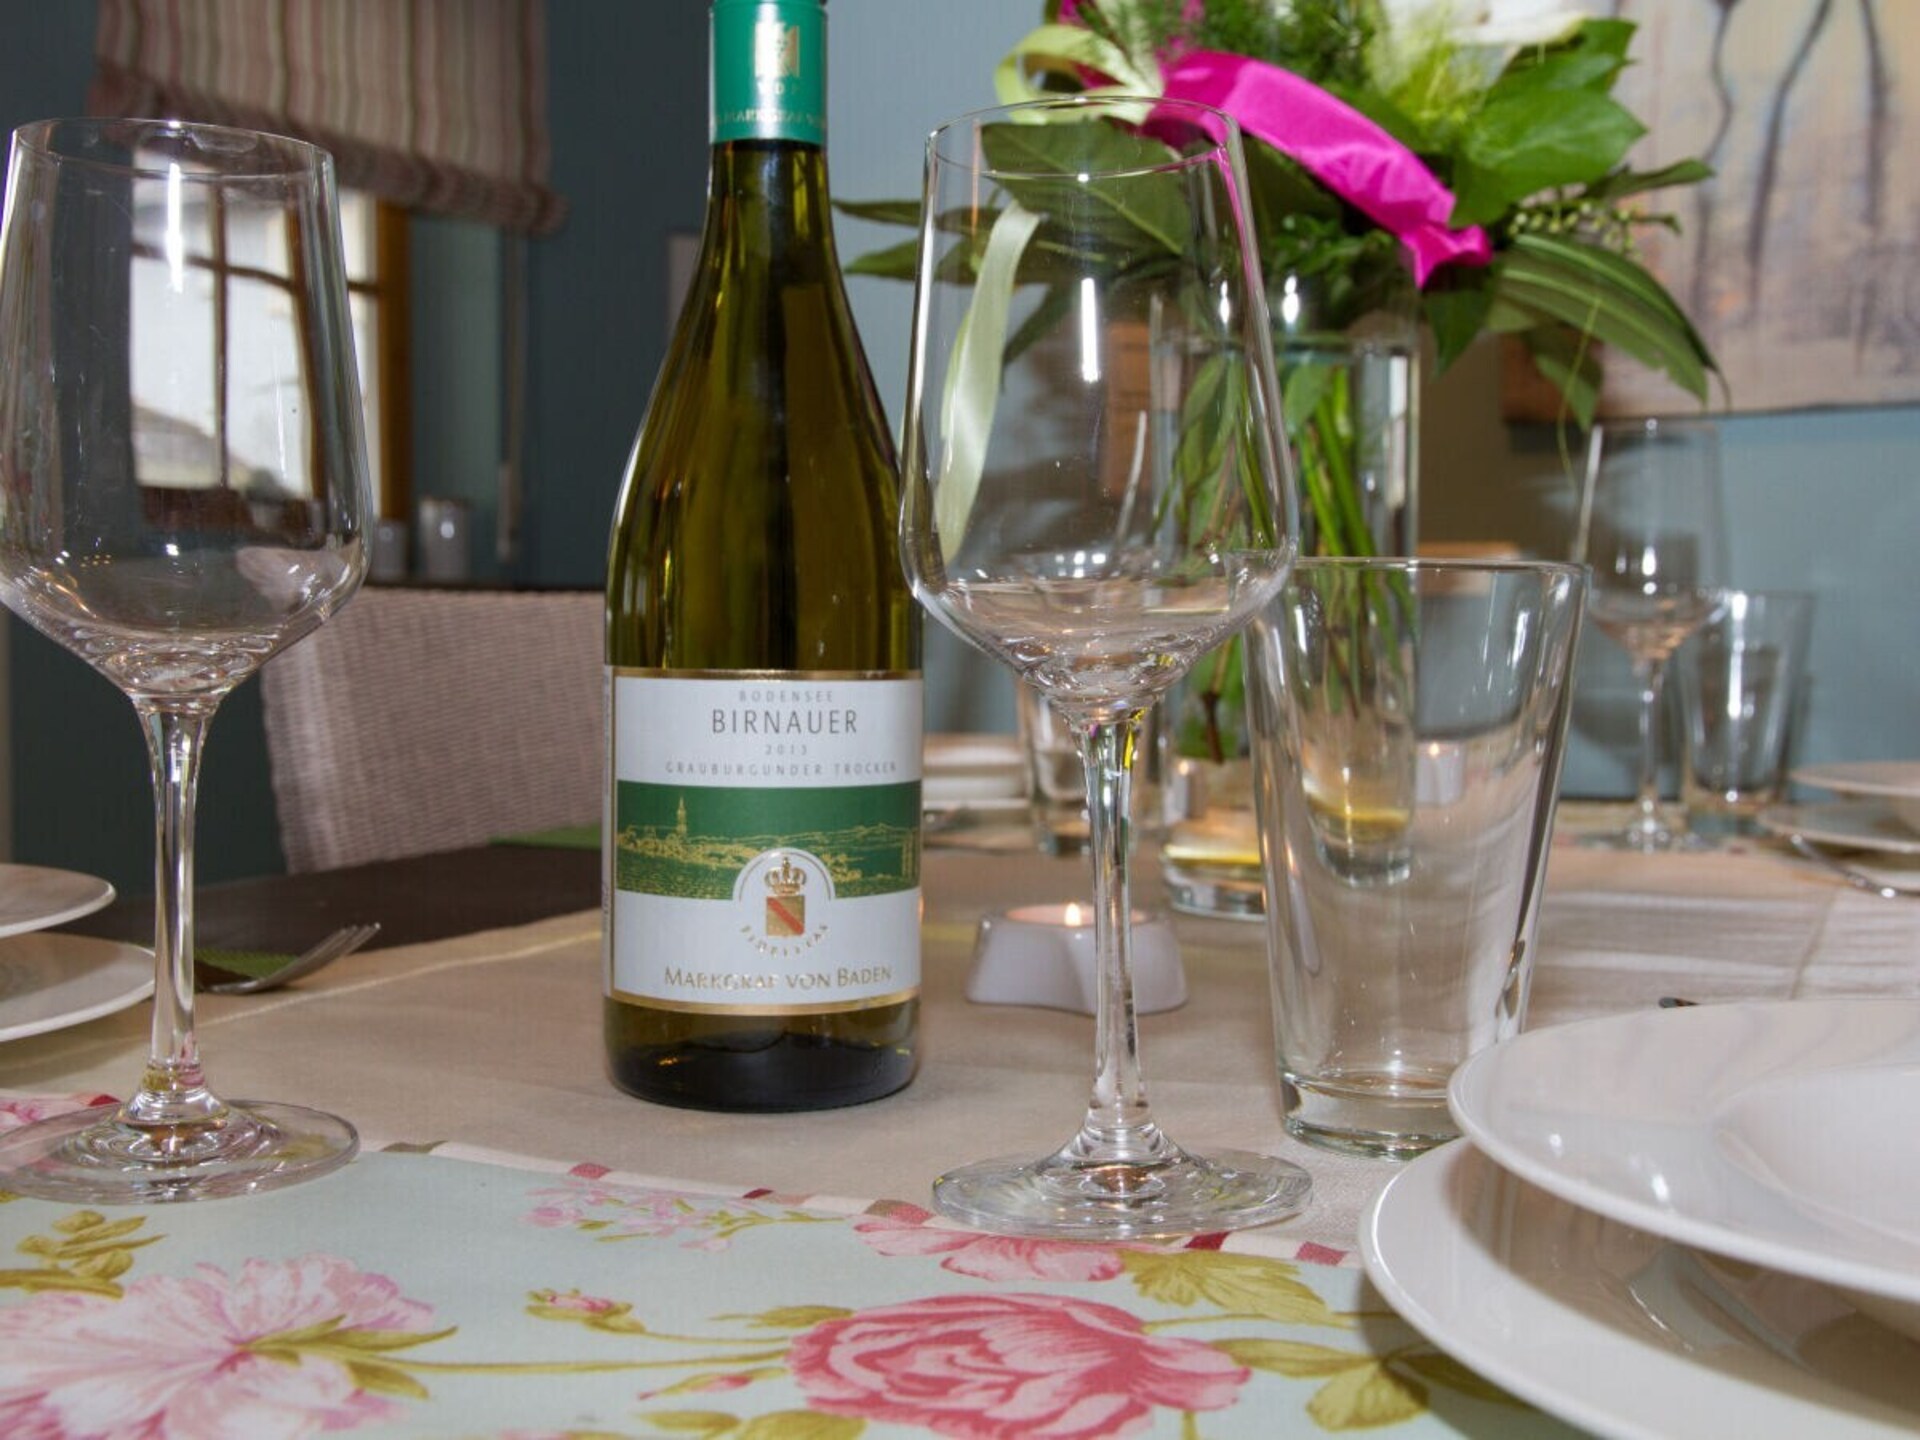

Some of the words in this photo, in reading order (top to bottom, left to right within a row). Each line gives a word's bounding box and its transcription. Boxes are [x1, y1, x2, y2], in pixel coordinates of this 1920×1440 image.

[739, 690, 833, 702] BODENSEE
[712, 709, 858, 734] BIRNAUER
[665, 761, 823, 777] GRAUBURGUNDER
[834, 761, 897, 776] TROCKEN
[664, 965, 779, 991] MARKGRAF
